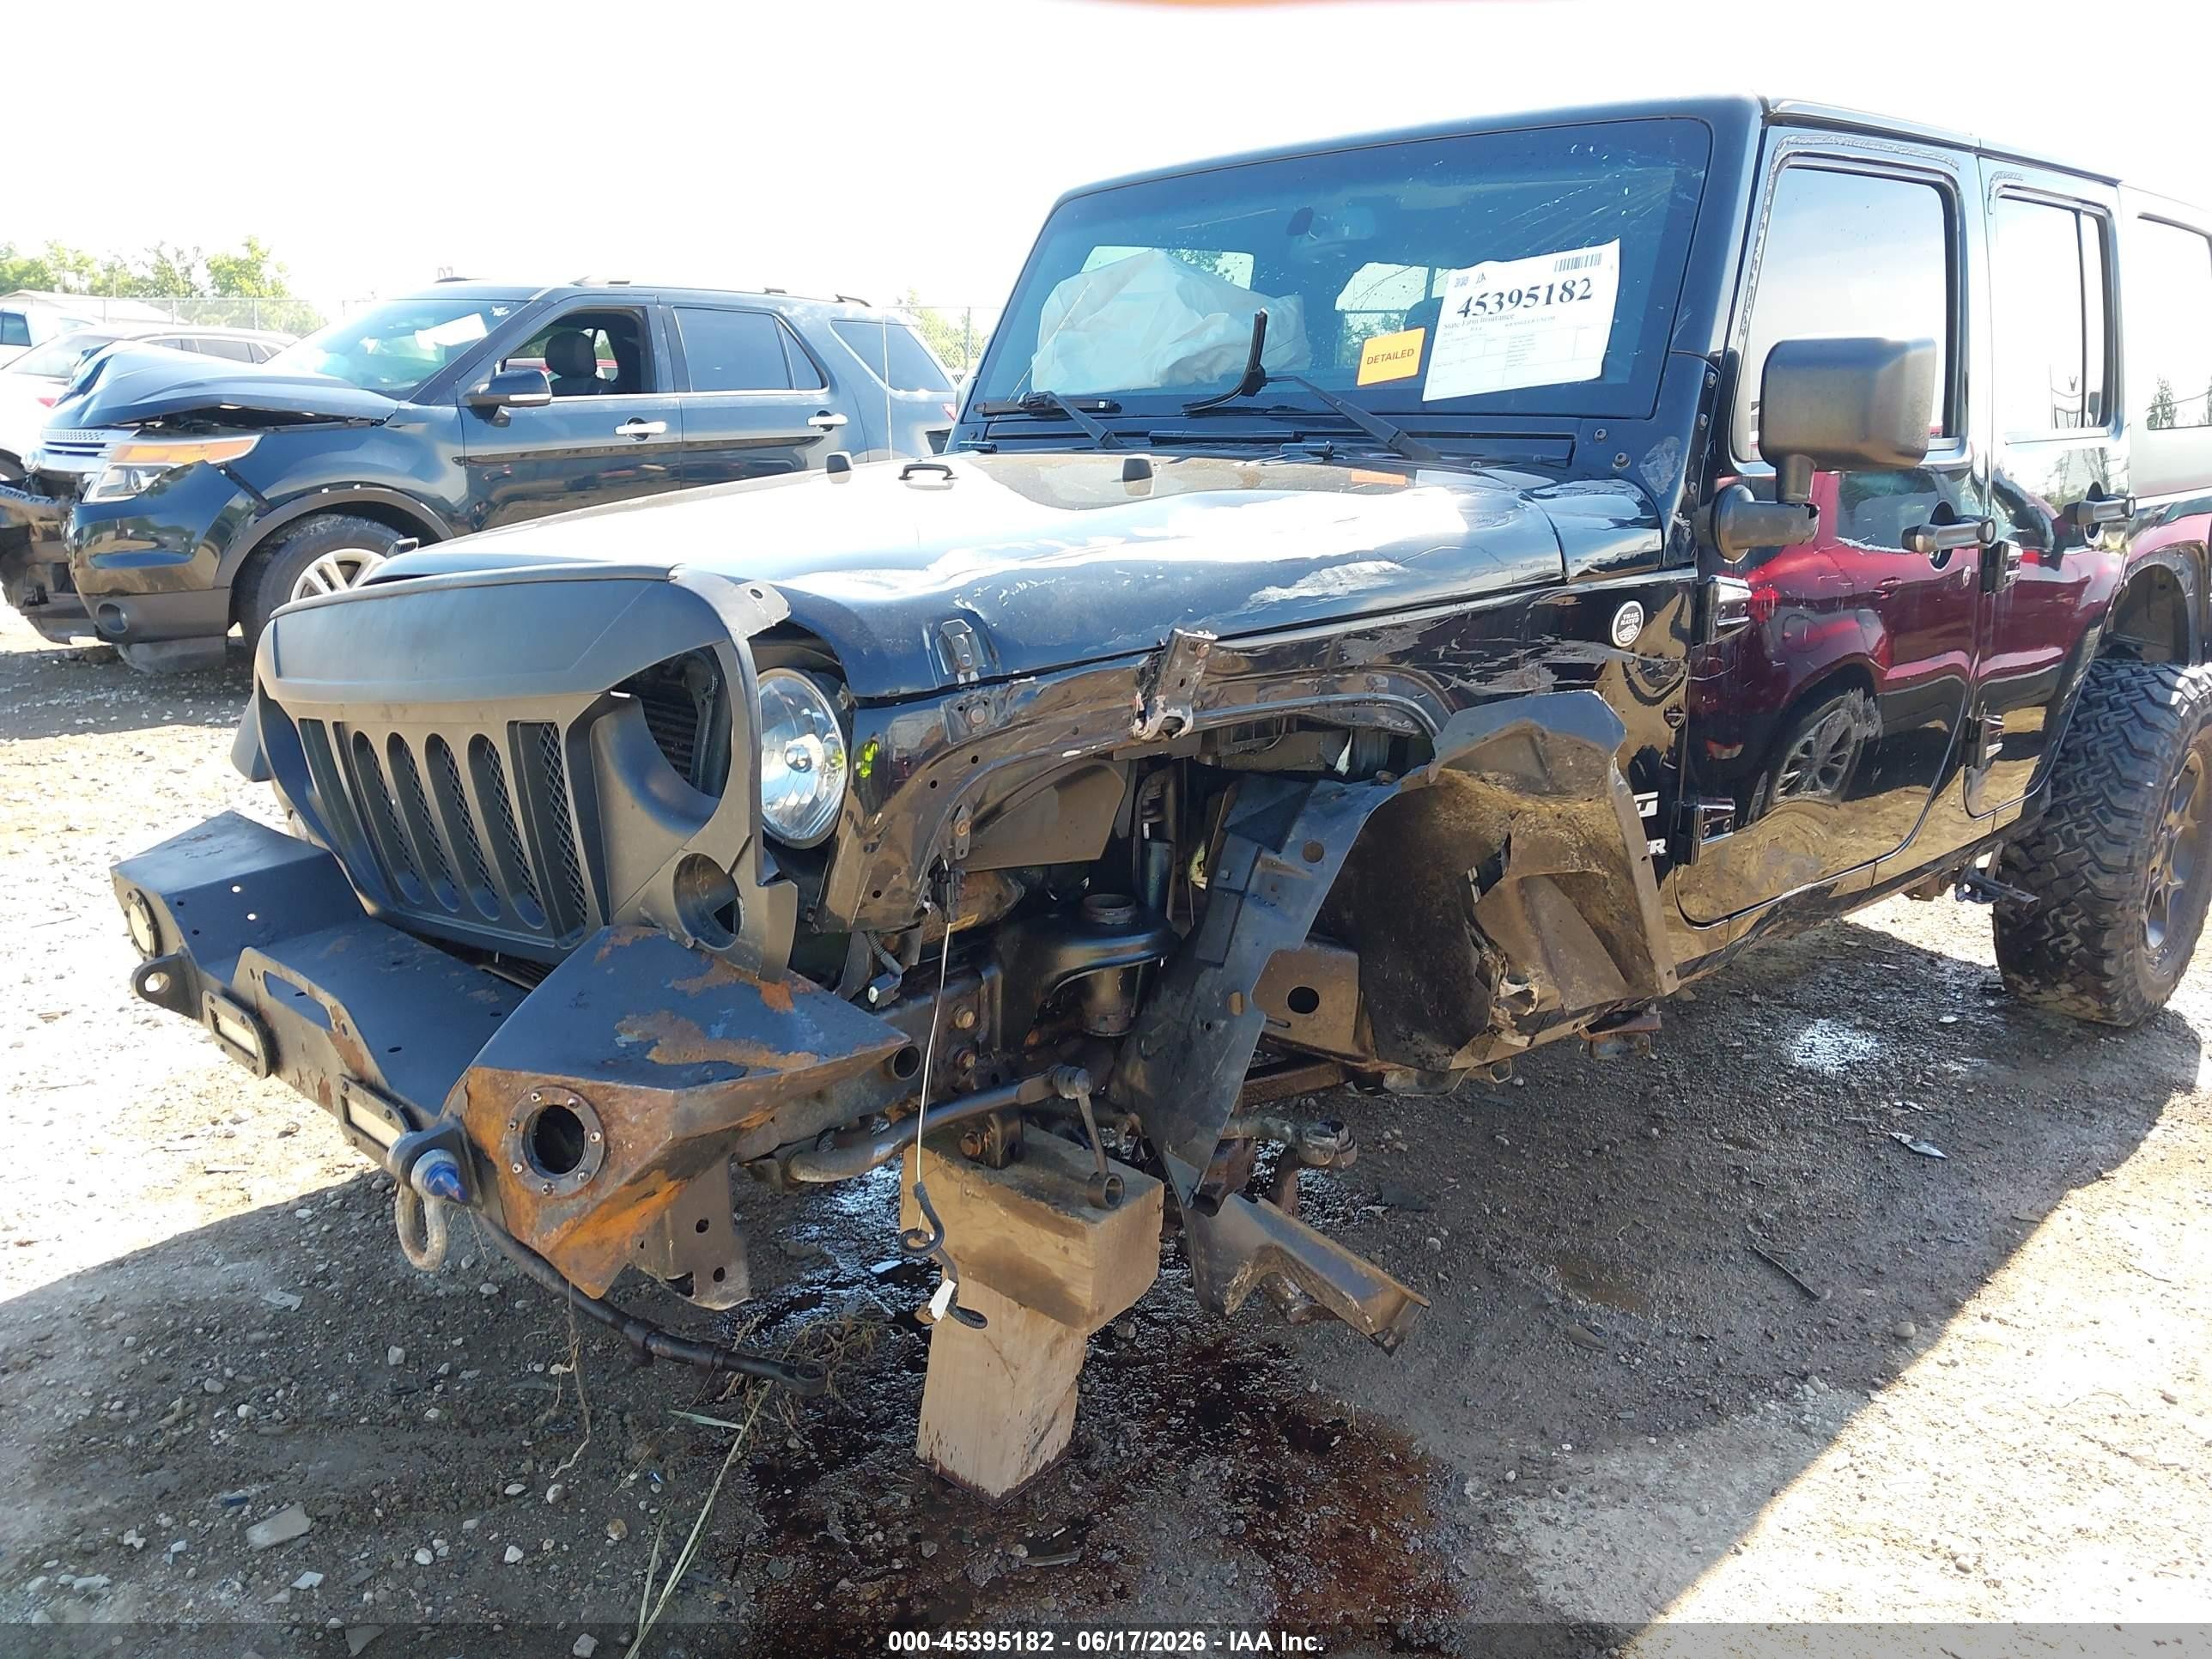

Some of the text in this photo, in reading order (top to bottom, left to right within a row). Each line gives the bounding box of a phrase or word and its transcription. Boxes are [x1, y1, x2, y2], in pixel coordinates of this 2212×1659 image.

[1457, 276, 1594, 318] 45395182
[1366, 348, 1415, 365] DETAILED
[1620, 617, 1640, 626] RATED
[1622, 611, 1641, 620] TRAIL
